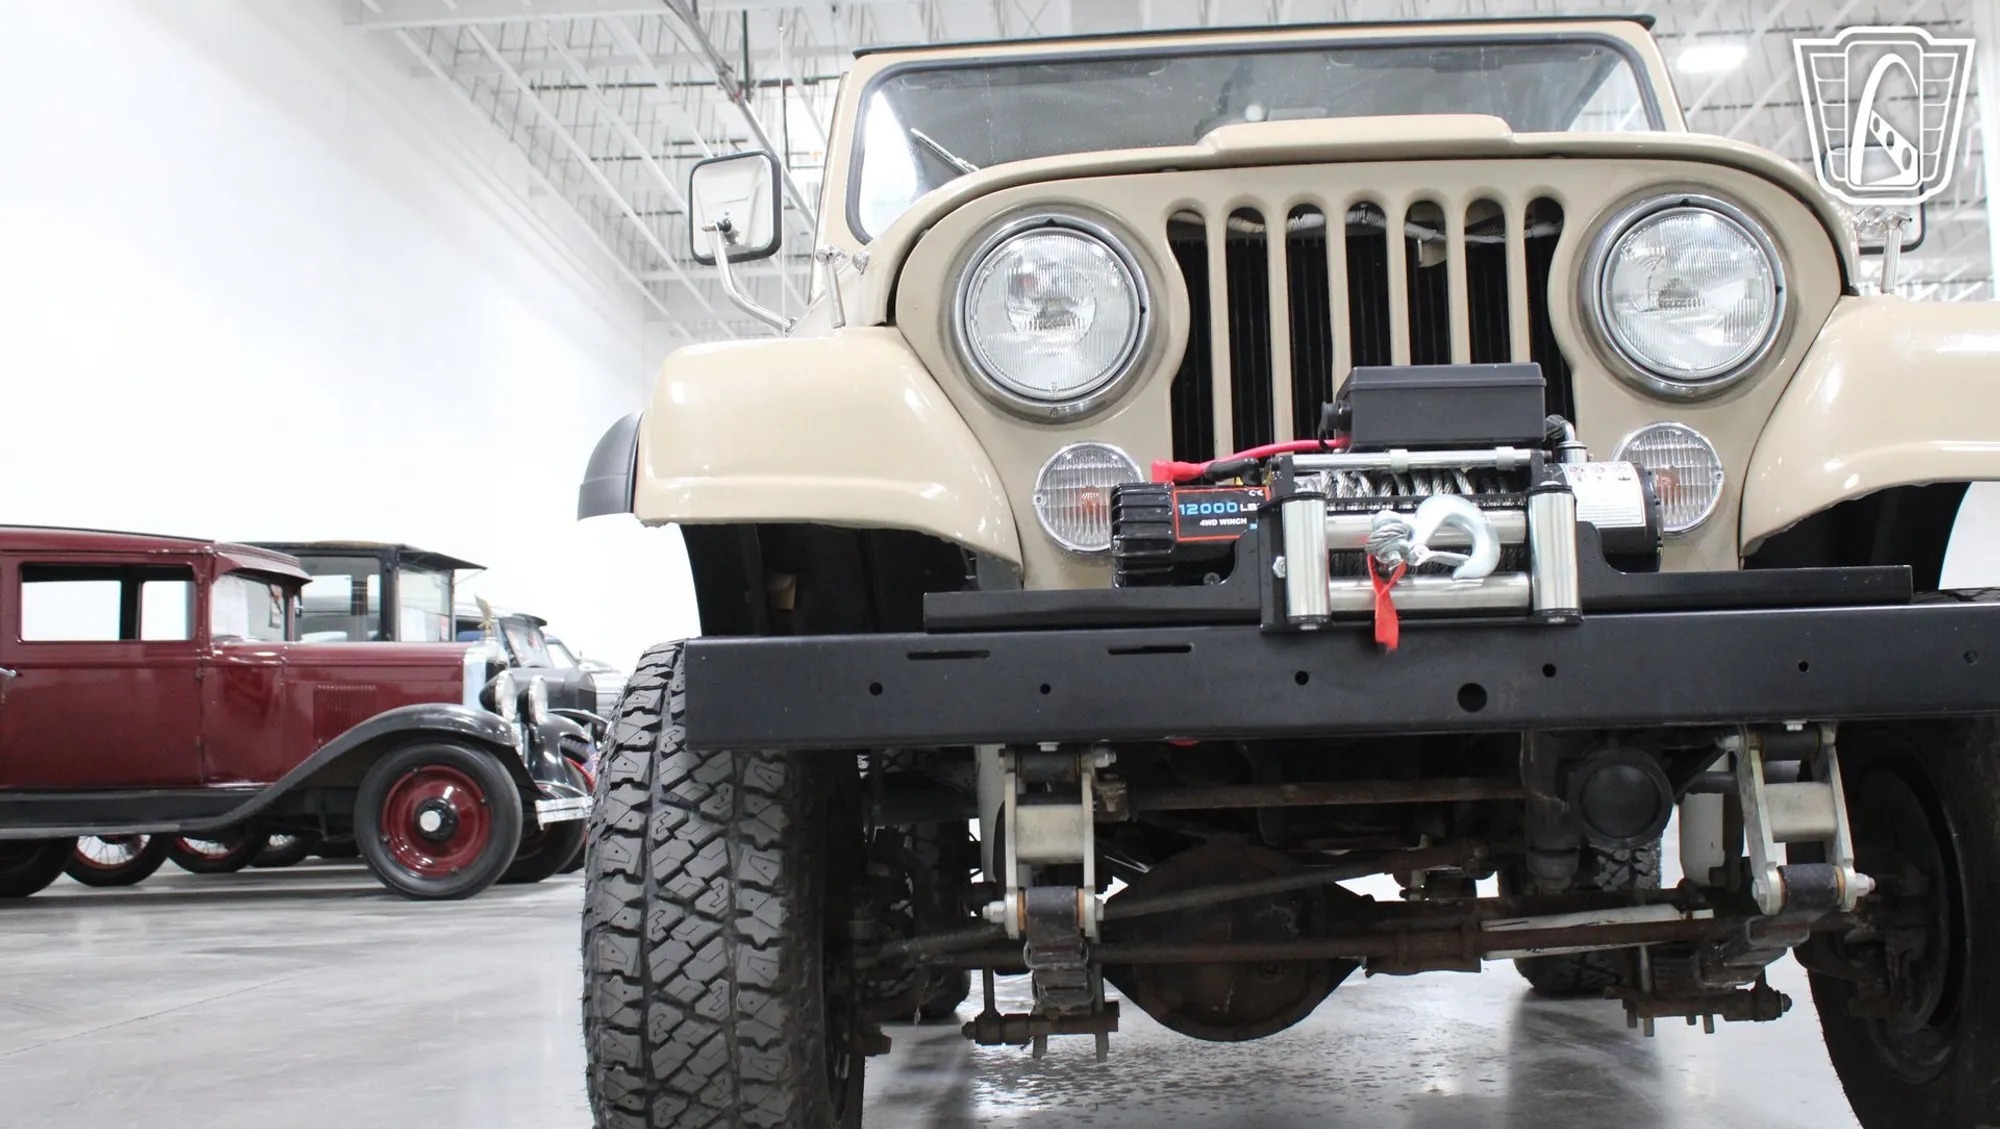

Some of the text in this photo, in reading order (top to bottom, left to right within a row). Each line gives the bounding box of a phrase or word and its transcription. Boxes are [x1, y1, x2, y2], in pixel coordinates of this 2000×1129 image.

[1178, 502, 1260, 515] 12000 LB
[1219, 517, 1247, 525] WINCH
